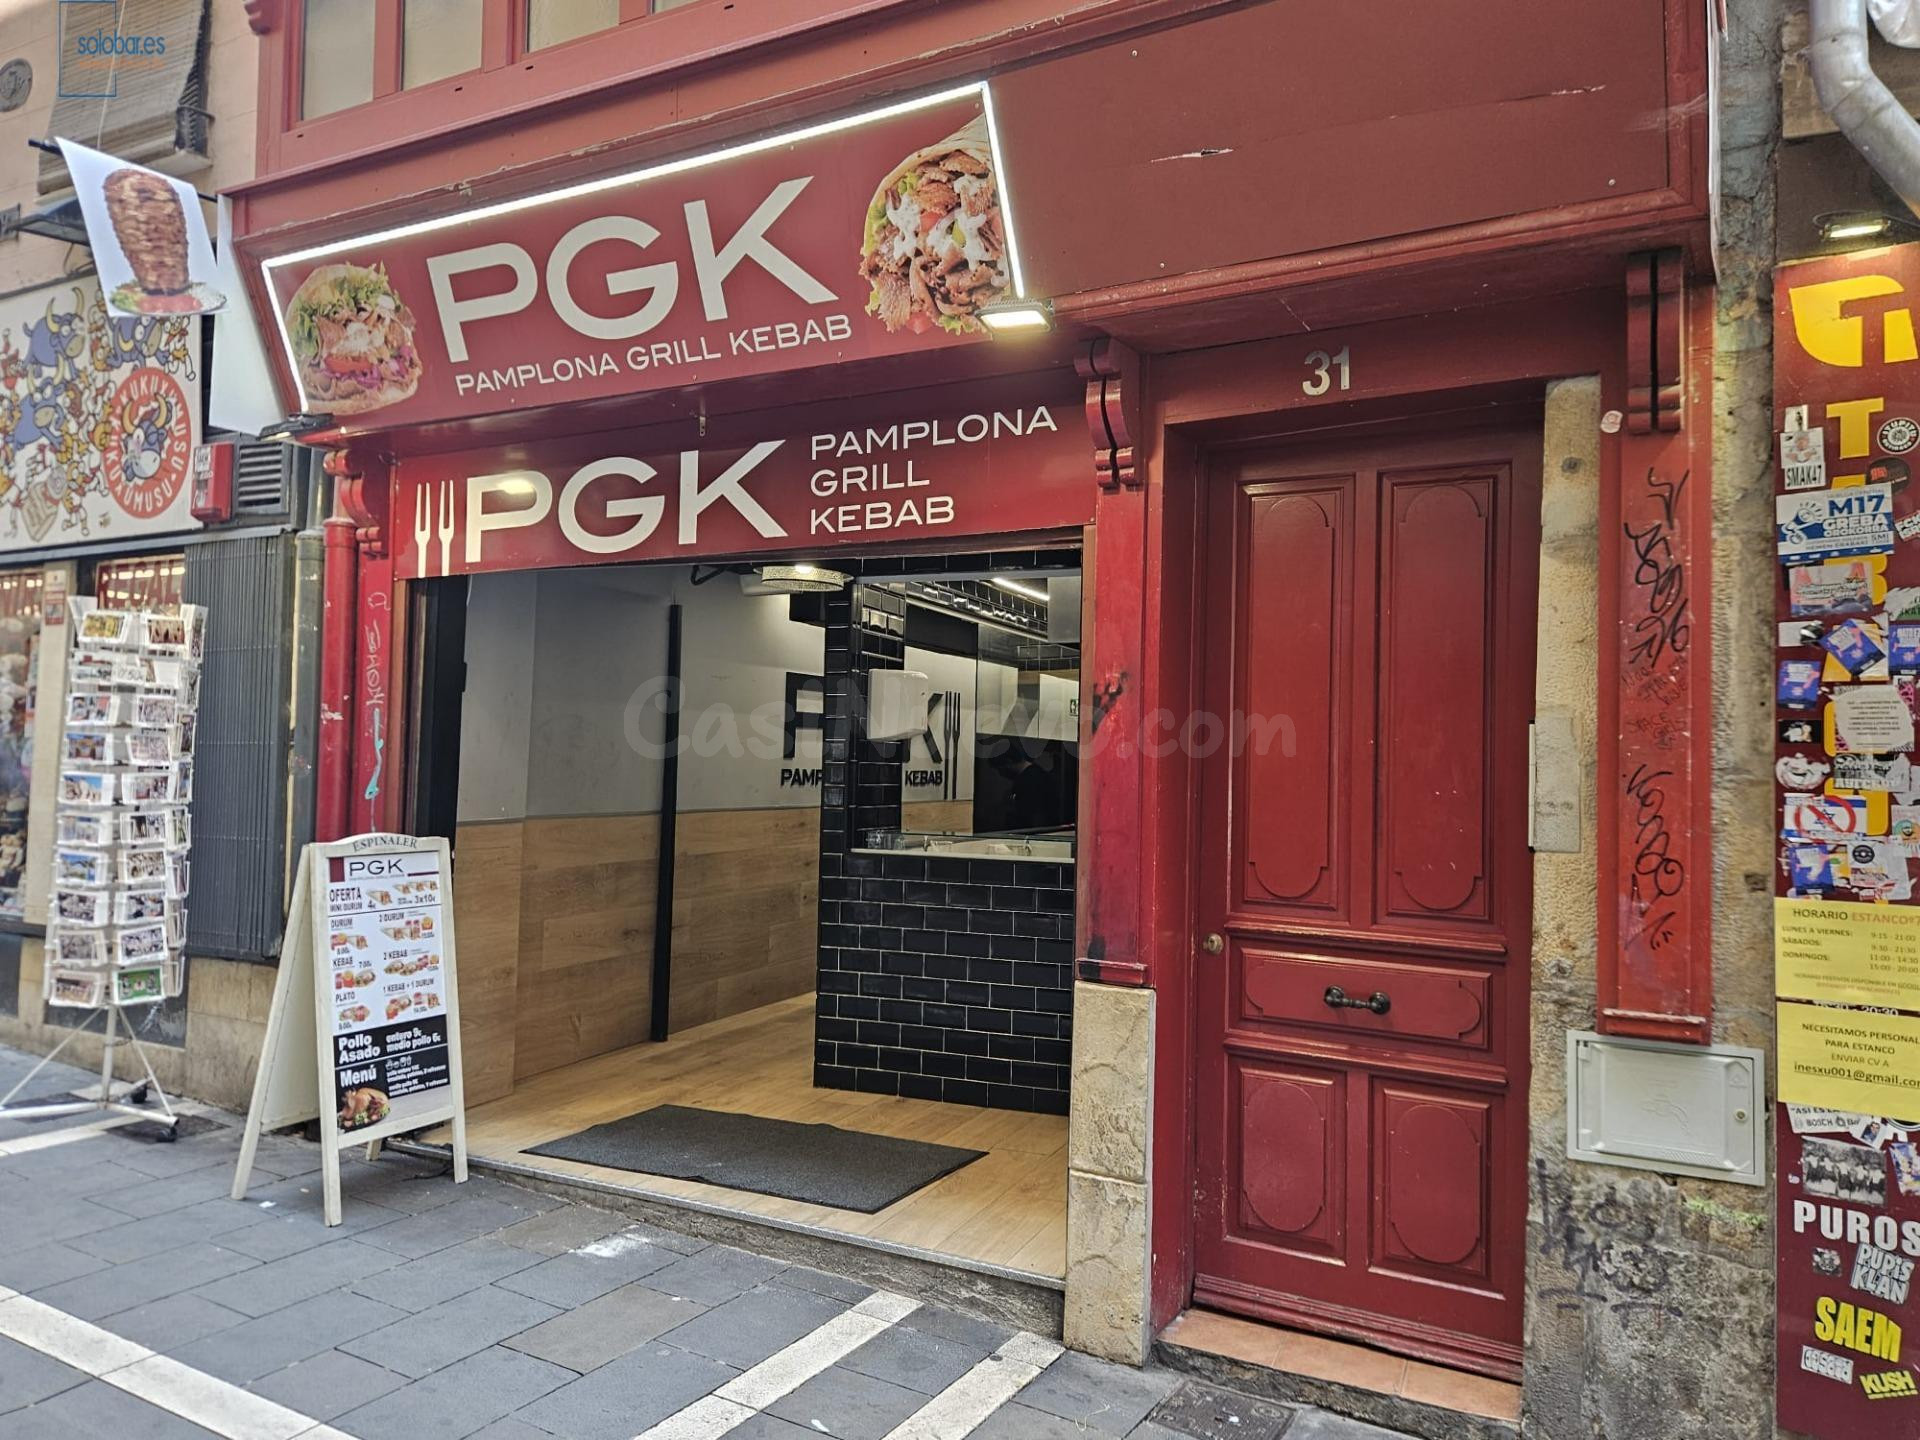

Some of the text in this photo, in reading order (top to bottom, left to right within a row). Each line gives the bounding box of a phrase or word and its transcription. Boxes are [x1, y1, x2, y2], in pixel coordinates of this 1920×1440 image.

[427, 176, 838, 363] PGK
[455, 314, 852, 396] PAMPLONA GRILL KEBAB
[1302, 345, 1350, 396] 31
[811, 405, 1057, 460] PAMPLONA
[810, 460, 930, 498] GRILL
[465, 440, 788, 563] PGK
[1828, 494, 1885, 517] M17
[810, 495, 955, 536] KEBAB
[1823, 513, 1888, 531] GREBA
[904, 770, 943, 787] KEBAB
[353, 836, 417, 852] ESPINALER
[349, 859, 403, 876] PGK
[329, 887, 362, 902] OFERTA
[1793, 908, 1848, 921] HORARIO
[338, 1033, 372, 1051] Pollo
[1802, 1023, 1920, 1045] NECESITAMOS PERSONAL
[339, 1045, 381, 1064] Asado
[1825, 1039, 1895, 1055] PARA ESTANCO
[1831, 1053, 1890, 1067] ENVIAR CV A
[340, 1064, 377, 1088] Menú
[1794, 1199, 1920, 1256] PUROS
[1852, 1264, 1910, 1305] KLAN
[1814, 1296, 1902, 1363] SAEM
[1860, 1370, 1916, 1395] KUSH
